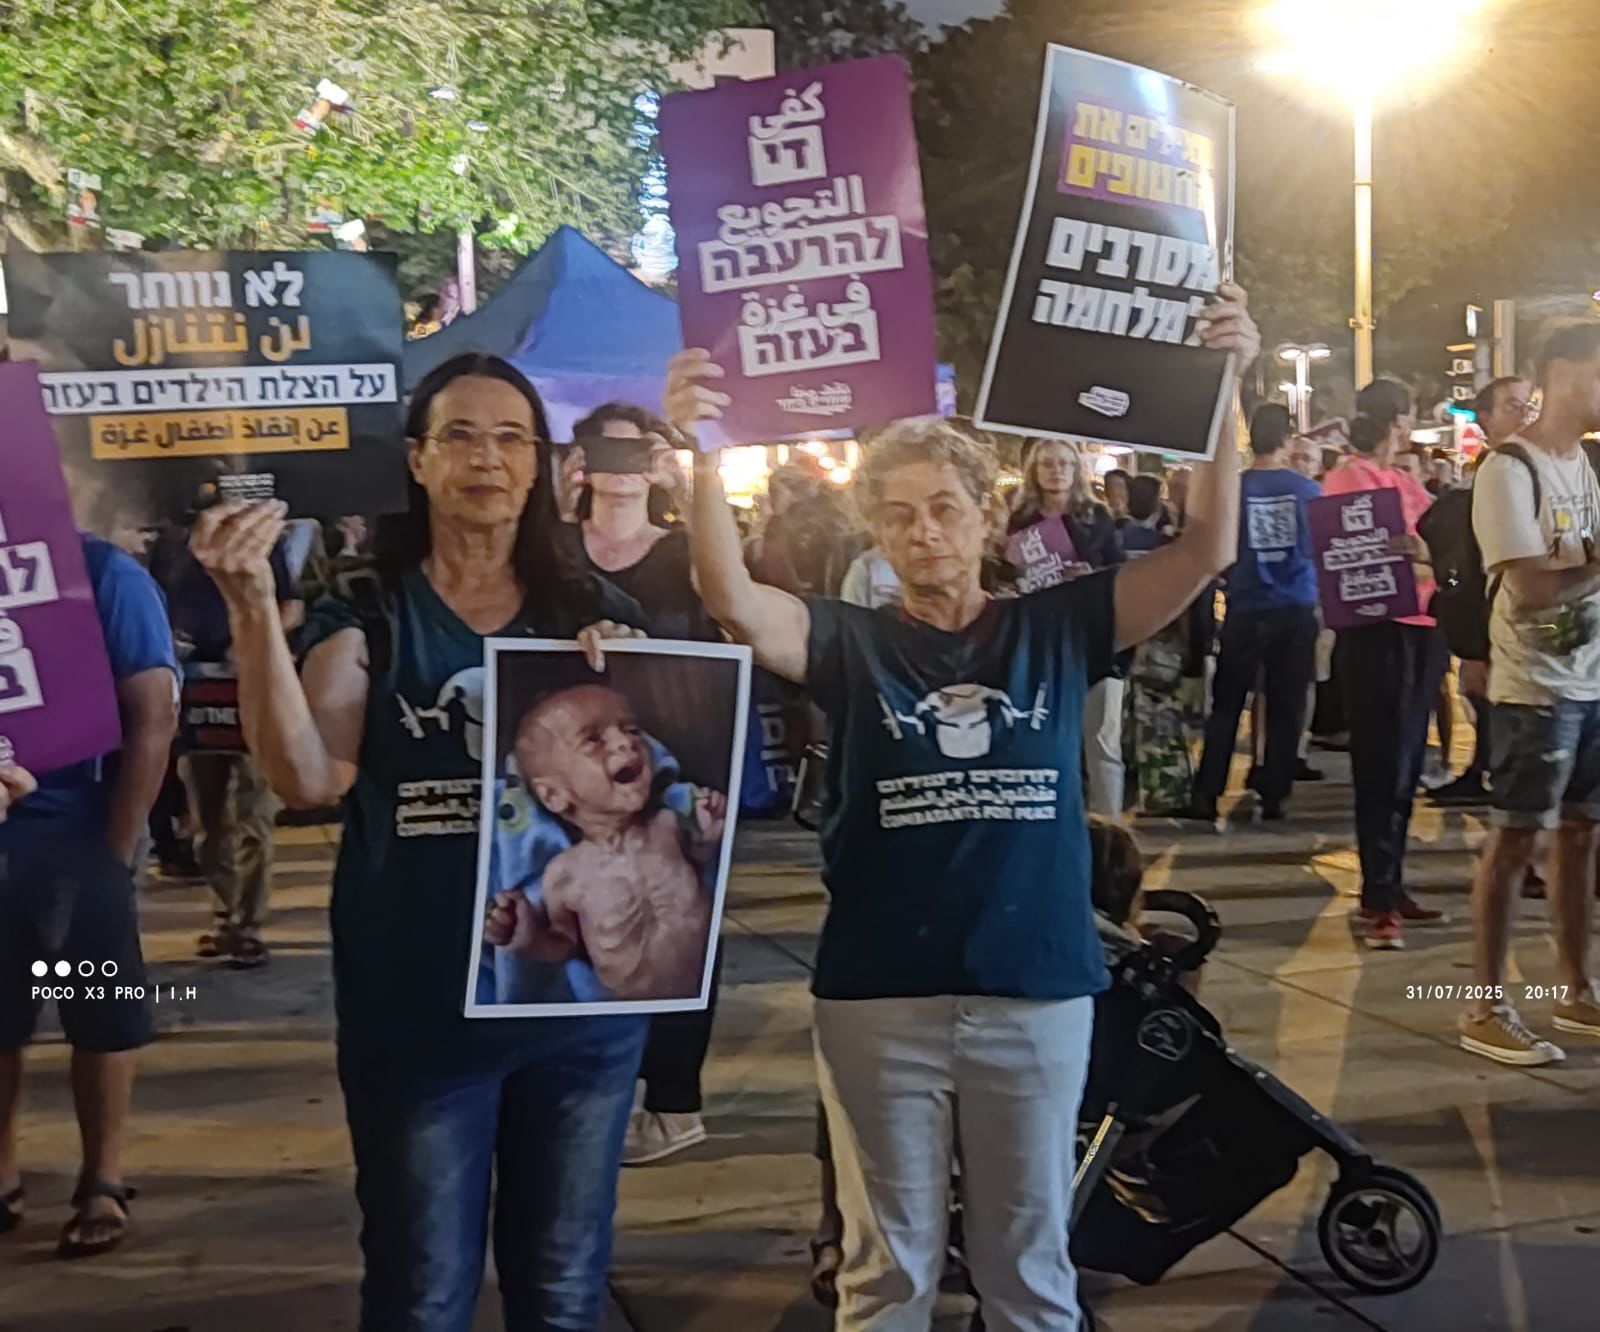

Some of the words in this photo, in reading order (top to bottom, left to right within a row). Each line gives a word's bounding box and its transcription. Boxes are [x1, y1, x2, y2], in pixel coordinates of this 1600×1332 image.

[748, 81, 826, 140] كفى
[1072, 101, 1123, 145] את
[762, 138, 809, 170] די
[1125, 114, 1214, 168] ילים
[717, 173, 867, 246] التجويع
[710, 220, 889, 282] להרעבה
[1045, 216, 1219, 294] מסרבים
[107, 270, 233, 311] נוותר
[243, 260, 304, 308] לא
[740, 283, 809, 333] غزة
[112, 311, 249, 367] نتنازل
[259, 314, 312, 368] لن
[754, 321, 868, 366] בעזה
[132, 371, 248, 405] הילדים
[258, 369, 340, 401] הצלת
[349, 367, 386, 399] על
[102, 419, 150, 450] غزة
[306, 417, 341, 443] عن
